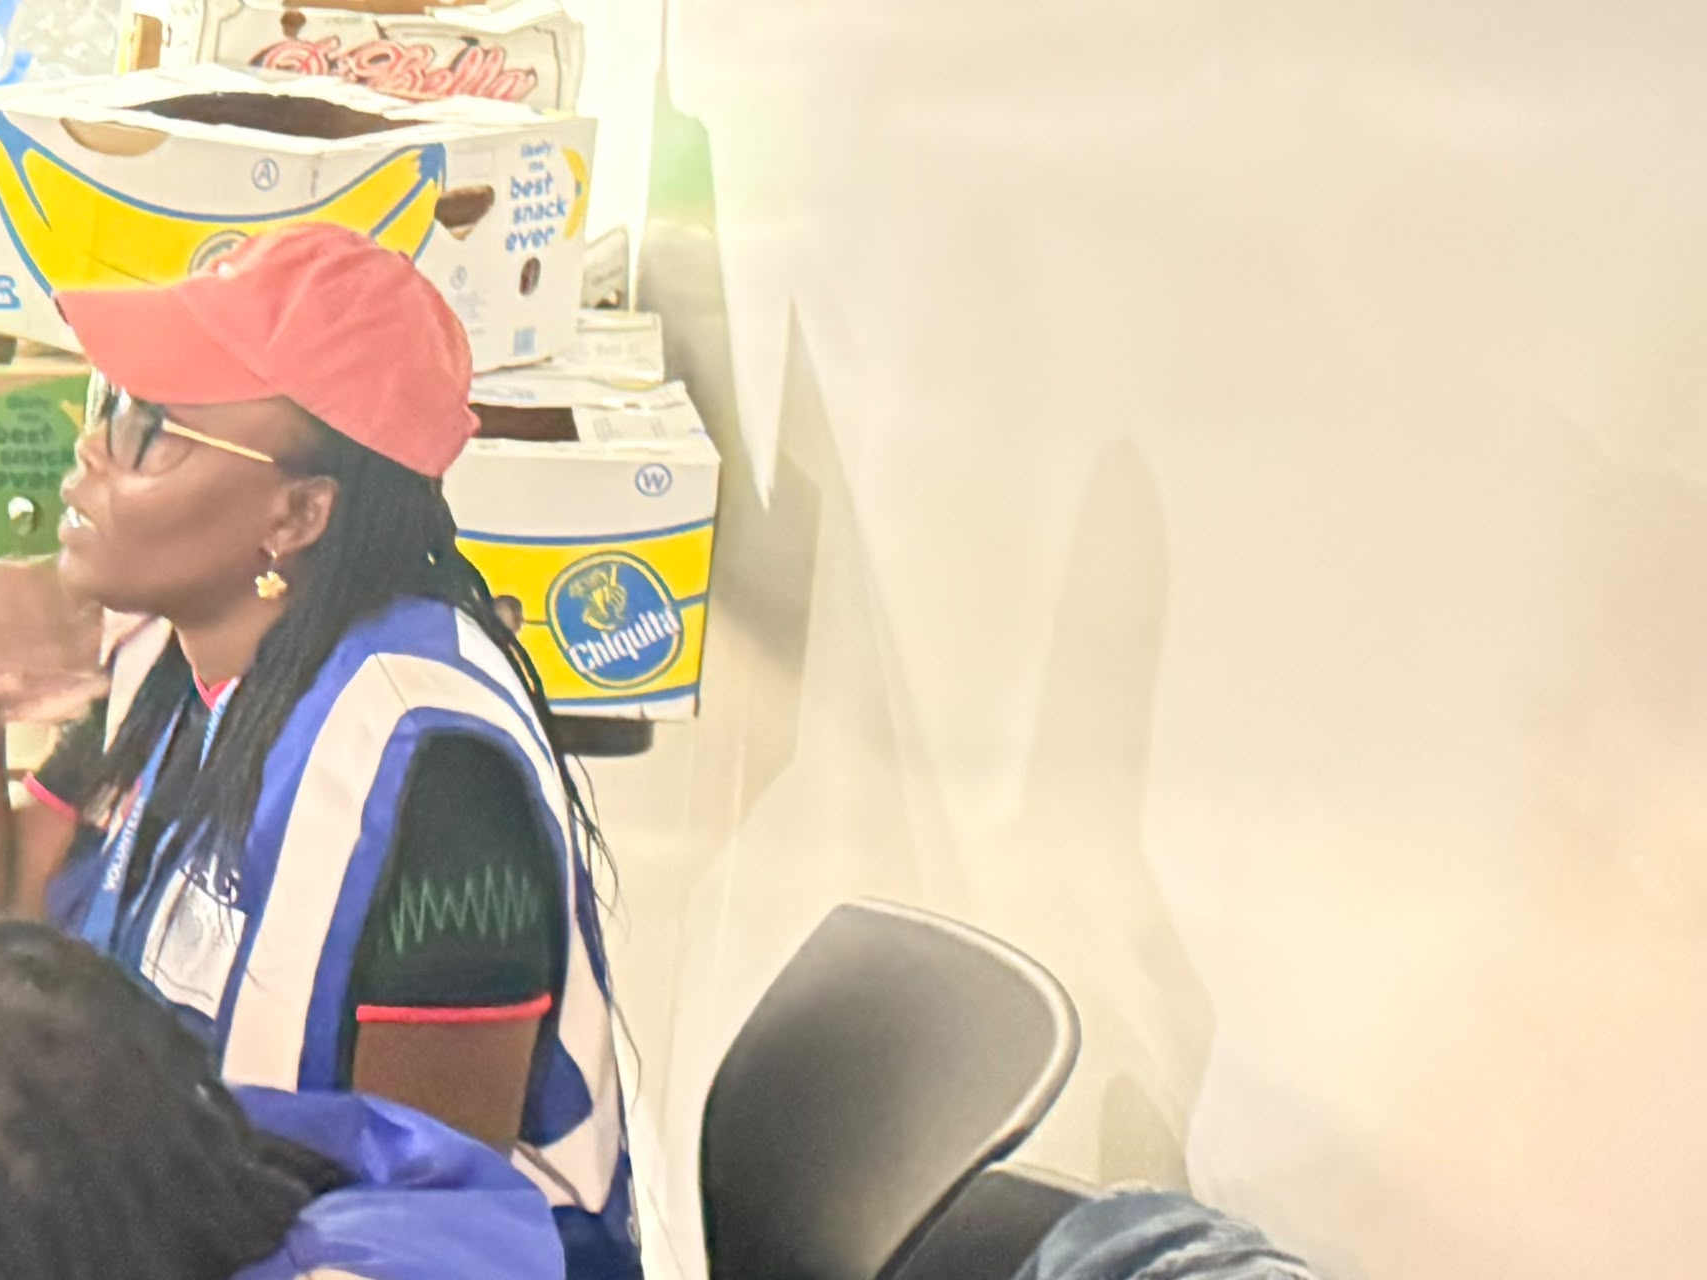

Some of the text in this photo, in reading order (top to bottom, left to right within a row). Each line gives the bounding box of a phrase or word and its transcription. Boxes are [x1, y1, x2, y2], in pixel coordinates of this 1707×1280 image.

[511, 175, 553, 199] best
[513, 195, 566, 226] snack
[505, 225, 555, 252] ever
[569, 607, 680, 674] Chiquita
